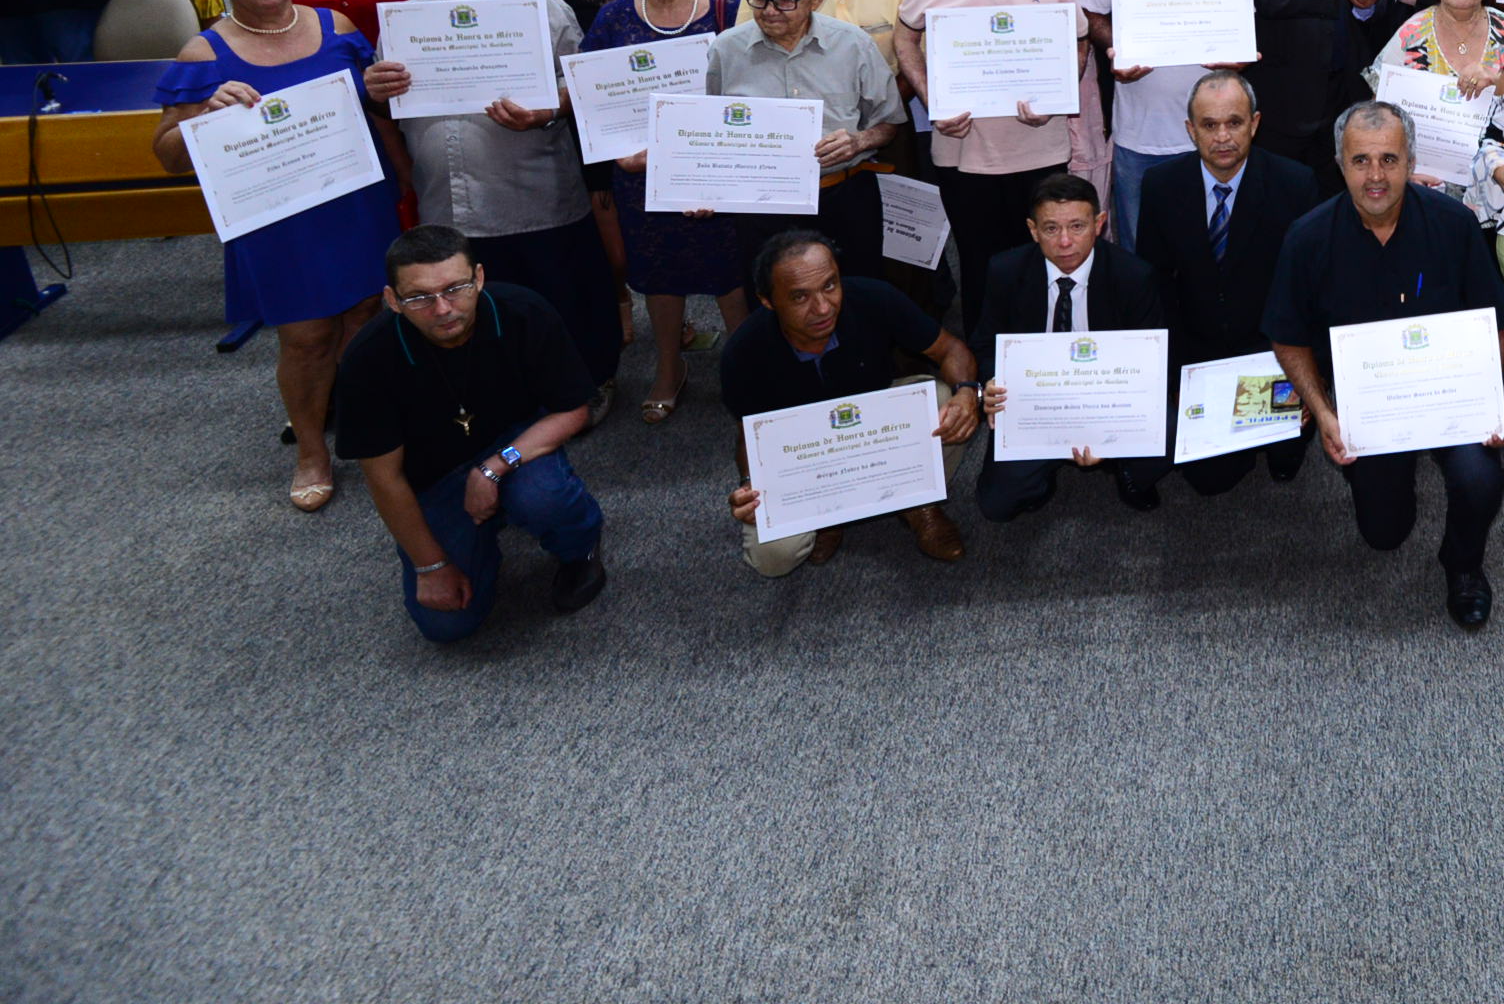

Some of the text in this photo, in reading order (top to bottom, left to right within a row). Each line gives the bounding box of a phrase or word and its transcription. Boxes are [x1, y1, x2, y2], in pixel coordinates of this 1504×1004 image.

[223, 135, 258, 154] Diploma
[271, 122, 296, 137] Honra
[309, 109, 336, 124] Mérito
[678, 129, 711, 138] Diploma
[726, 131, 751, 139] Honra
[767, 133, 794, 141] Mérito
[1025, 369, 1057, 378] Diploma
[1073, 368, 1097, 376] Honra
[1113, 366, 1141, 375] Mérito
[783, 439, 820, 454] Diploma
[837, 430, 864, 443] Honra
[881, 420, 911, 434] Mérito
